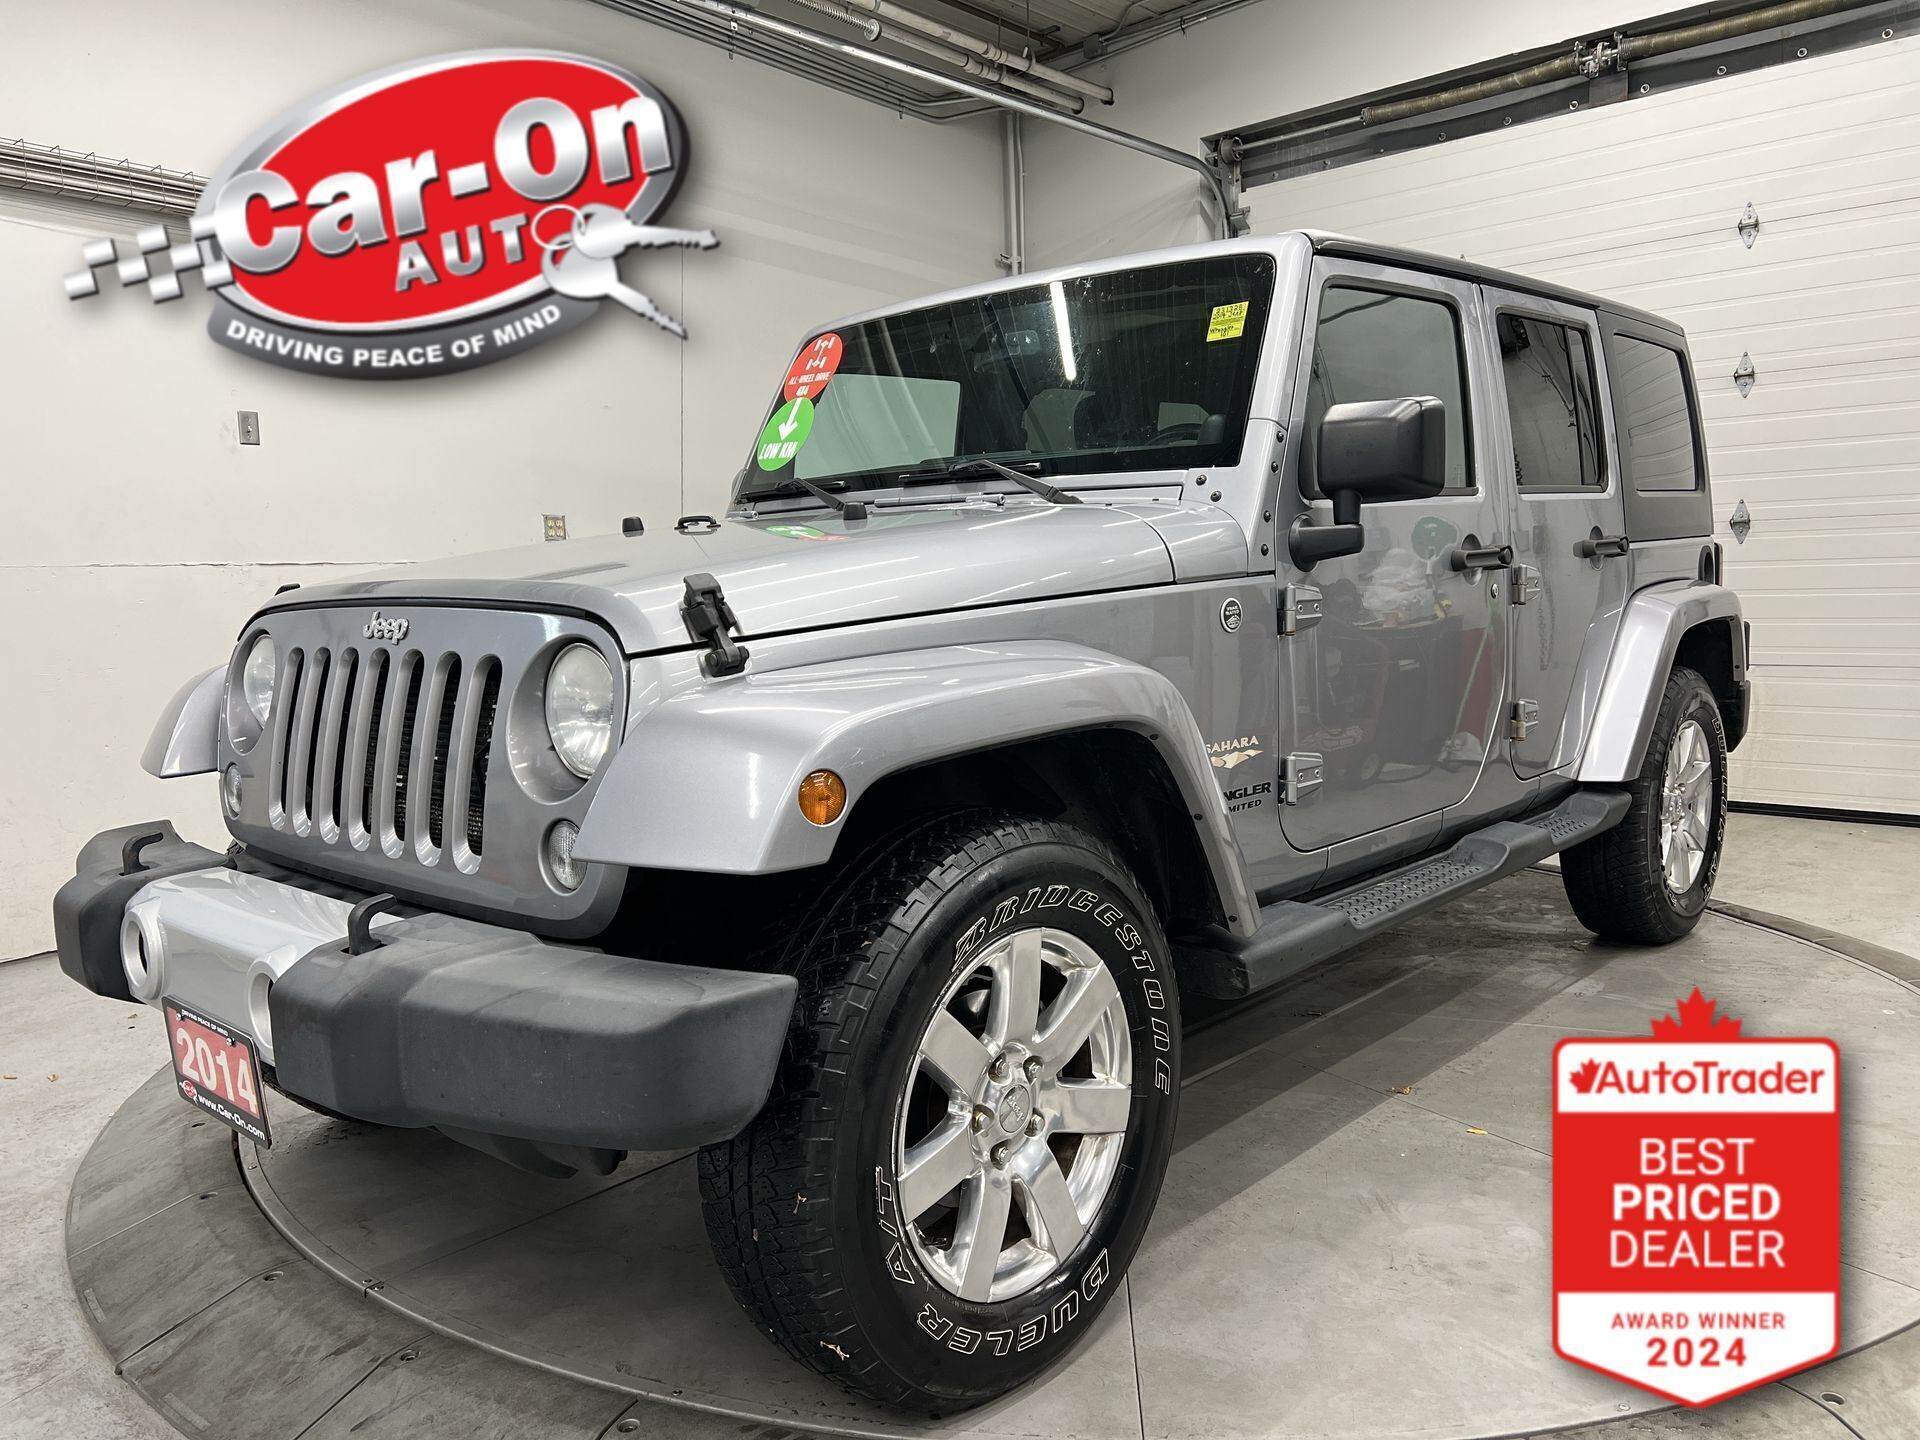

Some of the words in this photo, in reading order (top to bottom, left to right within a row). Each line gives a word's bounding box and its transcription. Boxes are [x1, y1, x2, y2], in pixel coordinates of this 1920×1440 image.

[814, 371, 832, 382] DRIVE
[758, 442, 780, 461] LOW
[362, 609, 410, 646] Jeep
[1204, 735, 1259, 754] SAHARA
[951, 884, 1171, 1096] BRIDGESTONE
[176, 1026, 258, 1115] 2014
[197, 1094, 266, 1141] www.Car-On.com
[916, 1248, 1110, 1357] DUELER
